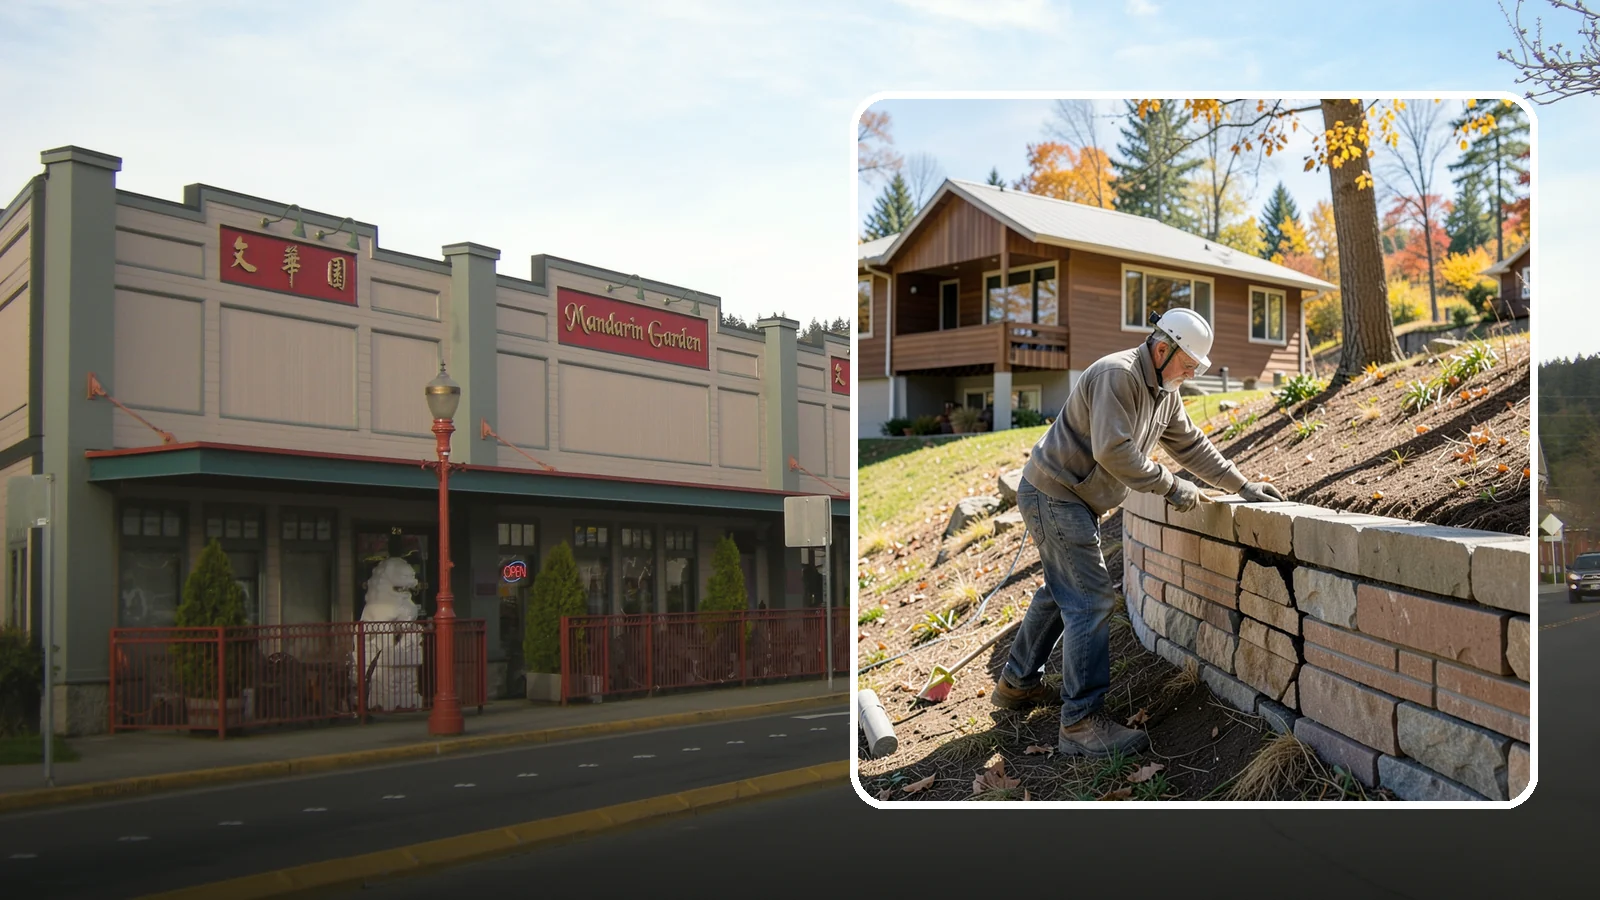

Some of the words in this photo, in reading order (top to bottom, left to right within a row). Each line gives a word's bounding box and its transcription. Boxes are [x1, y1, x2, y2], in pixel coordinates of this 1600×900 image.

[565, 302, 644, 341] Mandarin
[648, 320, 702, 352] Garden
[503, 565, 527, 578] OPEN
